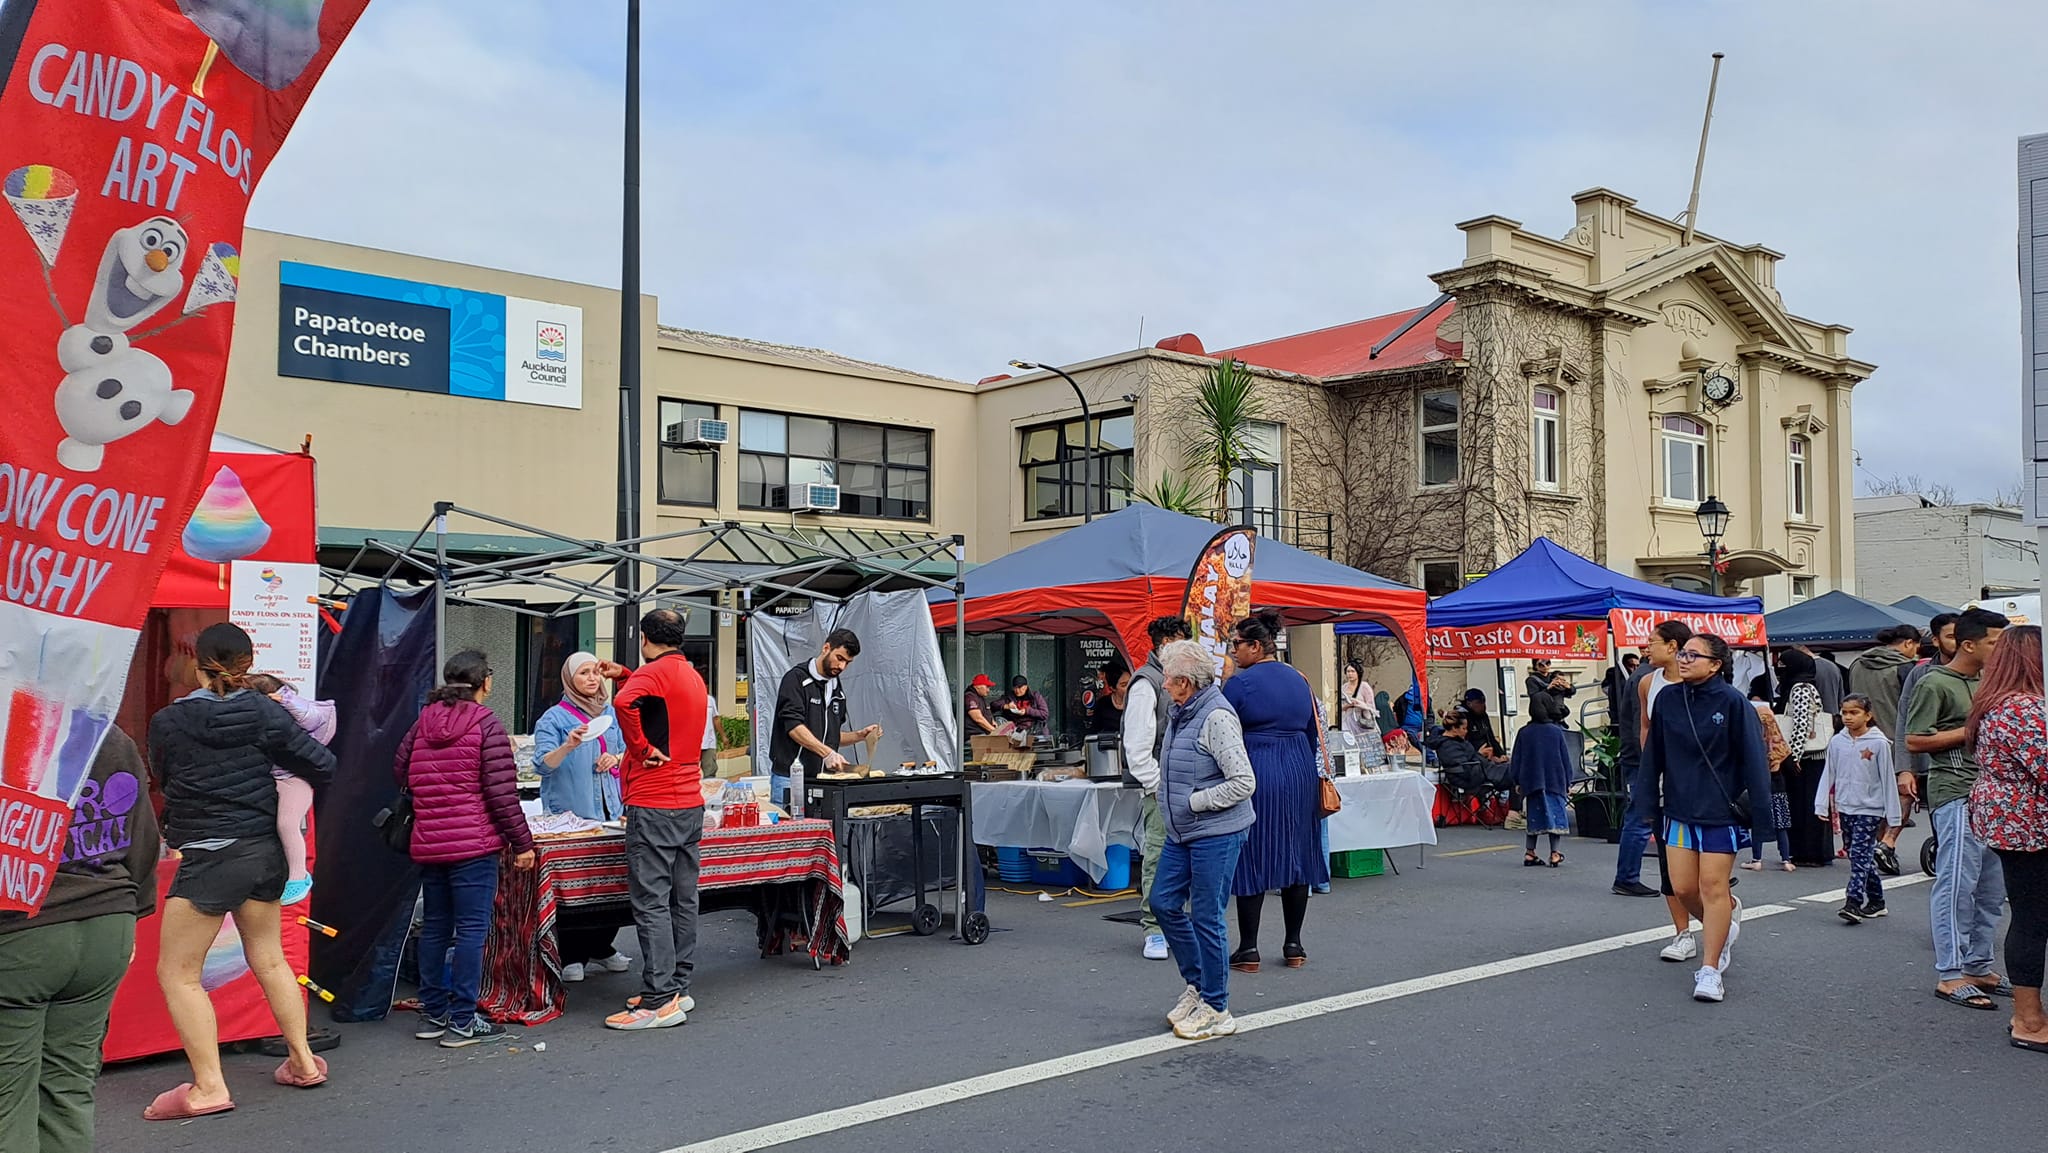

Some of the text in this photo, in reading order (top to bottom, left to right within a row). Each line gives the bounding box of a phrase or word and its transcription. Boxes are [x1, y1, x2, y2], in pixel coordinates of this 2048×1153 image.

[28, 43, 178, 130] CANDY
[100, 136, 197, 211] ART
[294, 307, 426, 343] Papatoetoe
[293, 335, 411, 367] Chambers
[521, 360, 567, 374] Auckland
[530, 371, 567, 384] Council
[57, 483, 165, 554] CONE
[0, 537, 113, 616] USHY
[1455, 627, 1513, 648] Taste
[1518, 624, 1567, 646] Otai
[1622, 609, 1655, 636] Red
[1705, 612, 1742, 636] Otai
[1080, 640, 1104, 649] TASTES
[1085, 649, 1115, 657] VICTORY
